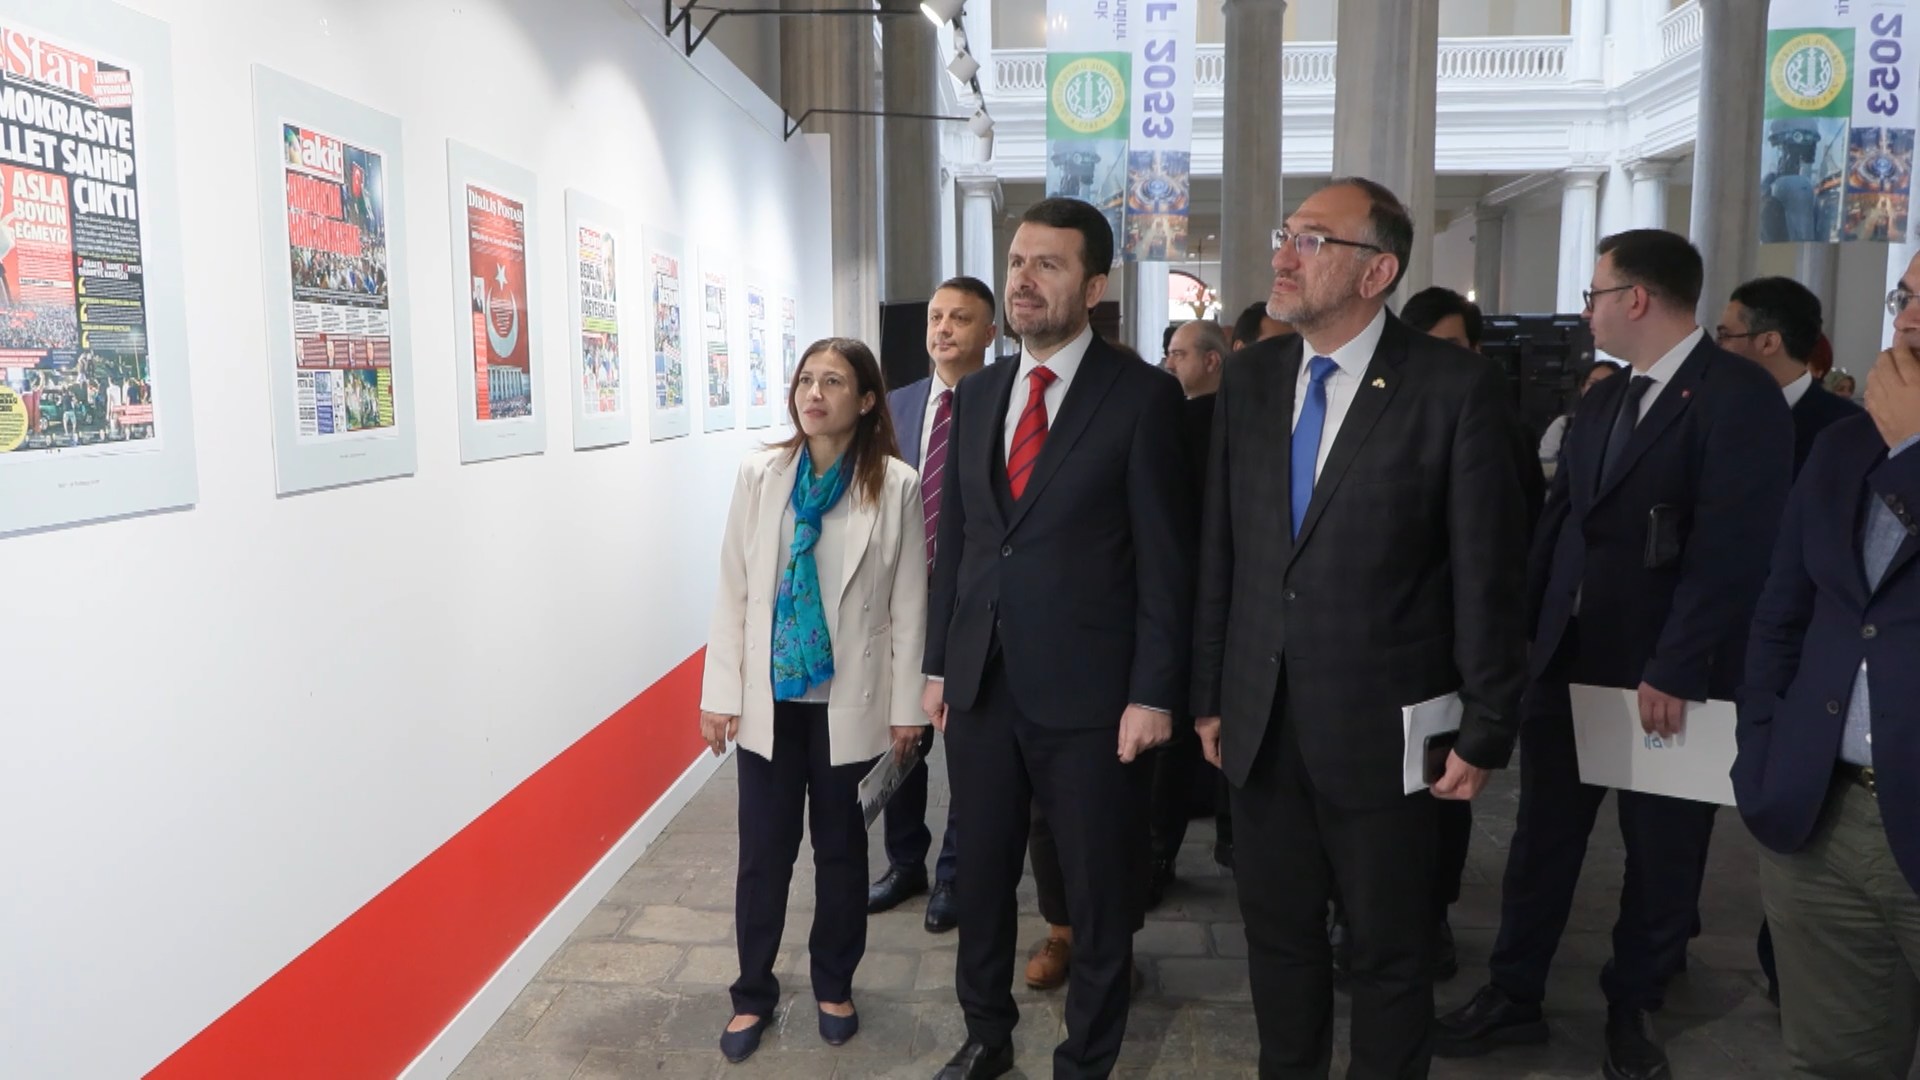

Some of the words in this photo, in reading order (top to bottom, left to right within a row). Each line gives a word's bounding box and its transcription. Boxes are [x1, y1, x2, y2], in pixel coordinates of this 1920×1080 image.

[6, 29, 88, 93] Star
[61, 139, 134, 184] SAHİP
[303, 134, 342, 172] akit
[12, 170, 66, 204] ASLA
[73, 177, 136, 220] ÇIKTI
[14, 198, 66, 226] BOYUN
[15, 222, 68, 245] EĞMEYİZ
